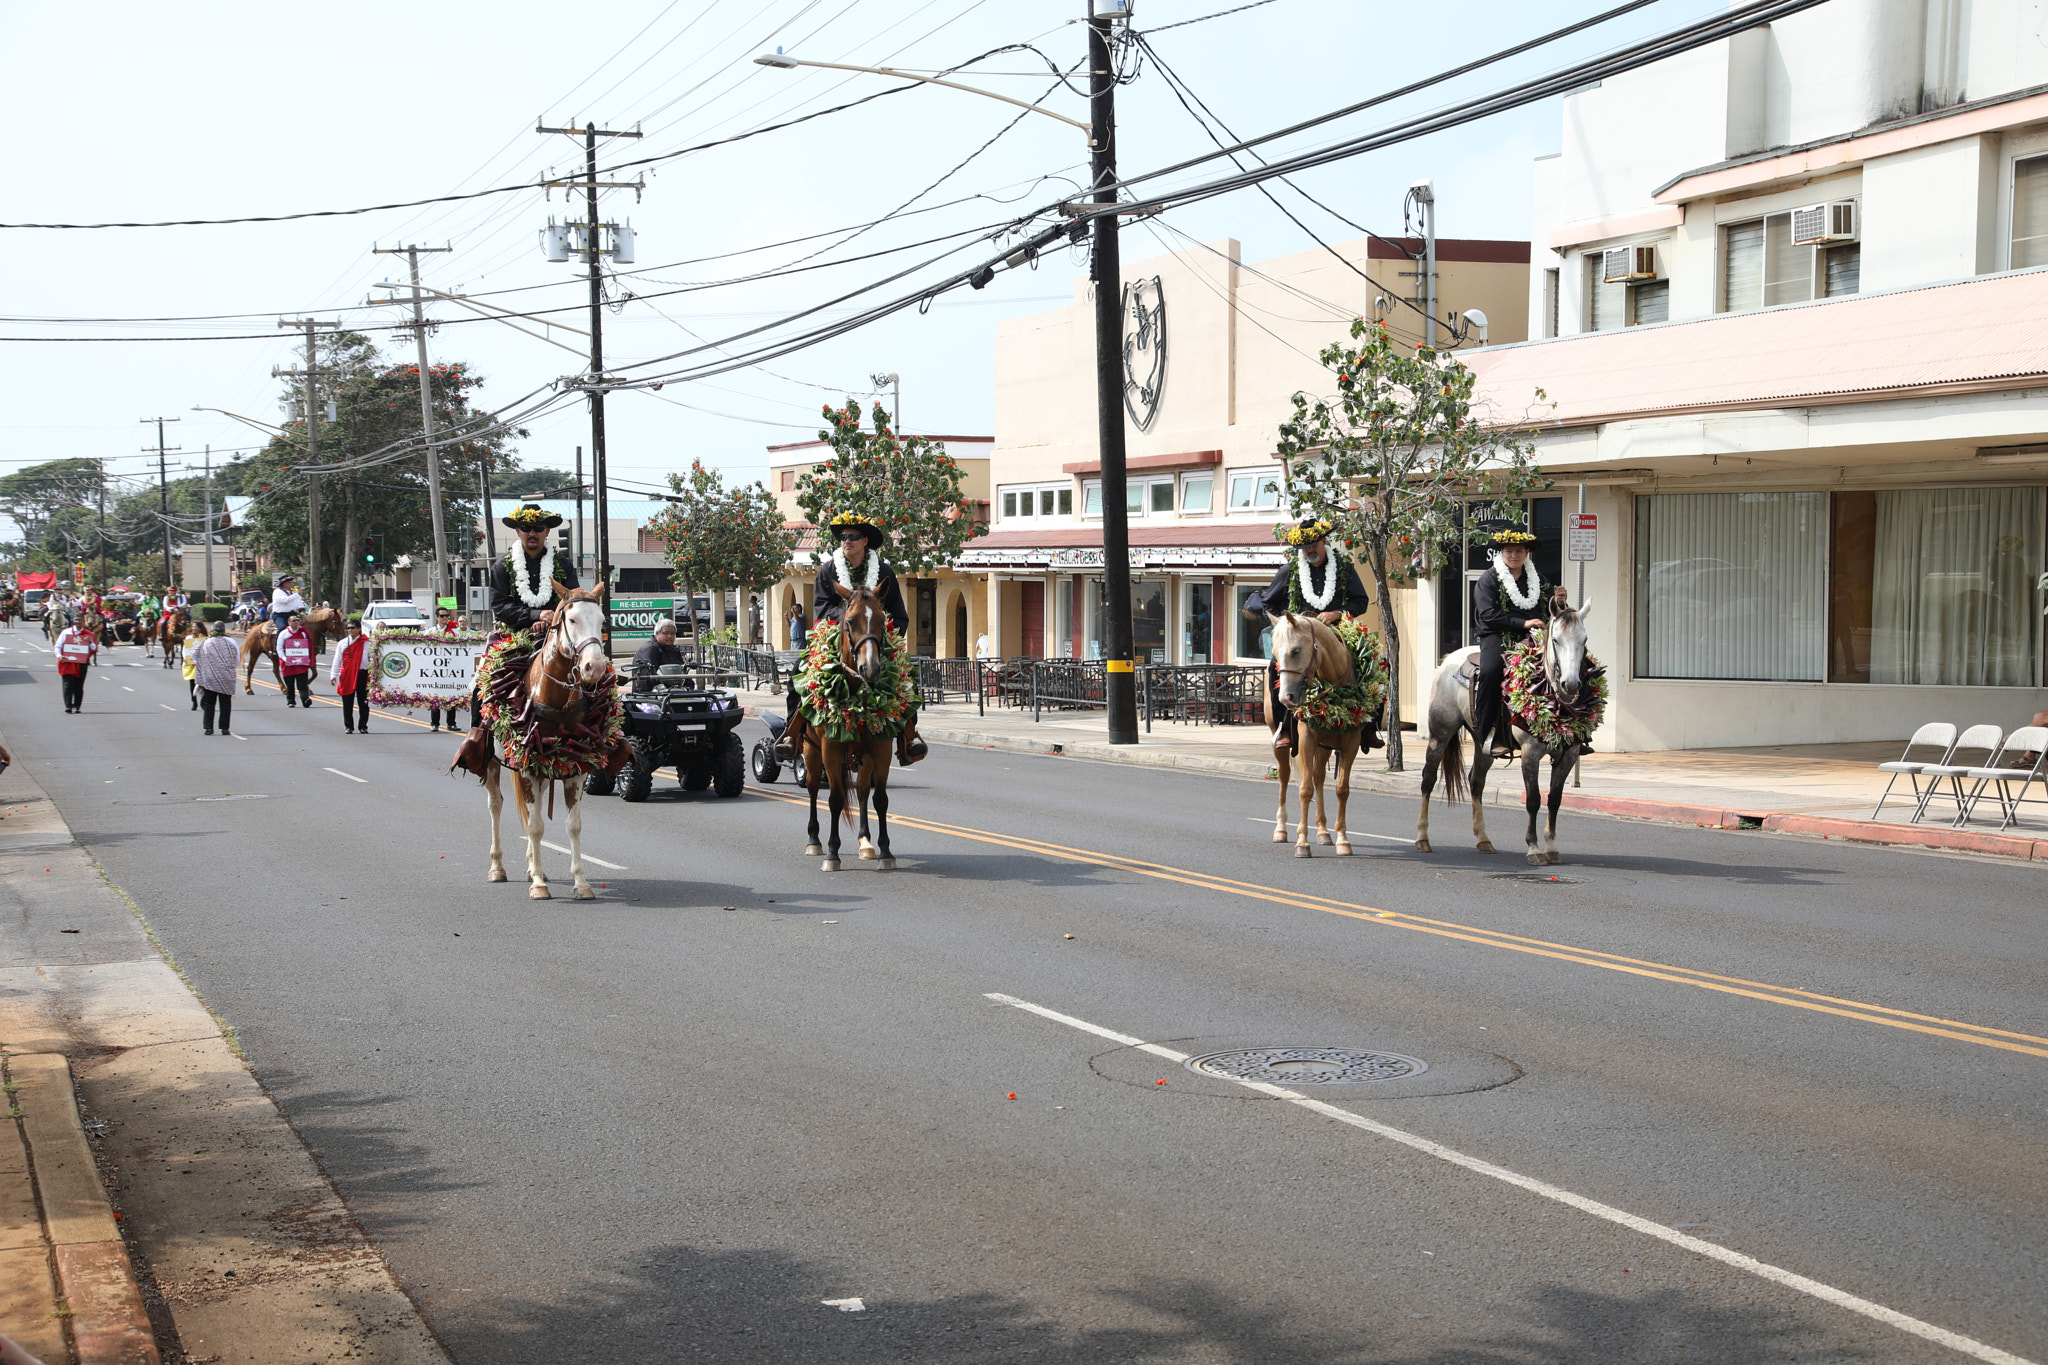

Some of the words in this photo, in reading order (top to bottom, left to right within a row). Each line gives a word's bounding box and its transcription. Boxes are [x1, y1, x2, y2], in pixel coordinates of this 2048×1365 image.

[1571, 517, 1578, 527] NO
[610, 612, 665, 627] TOKIOKA
[413, 647, 472, 657] COUNTY
[433, 658, 452, 667] OF
[415, 682, 469, 690] www.kauai.gov
